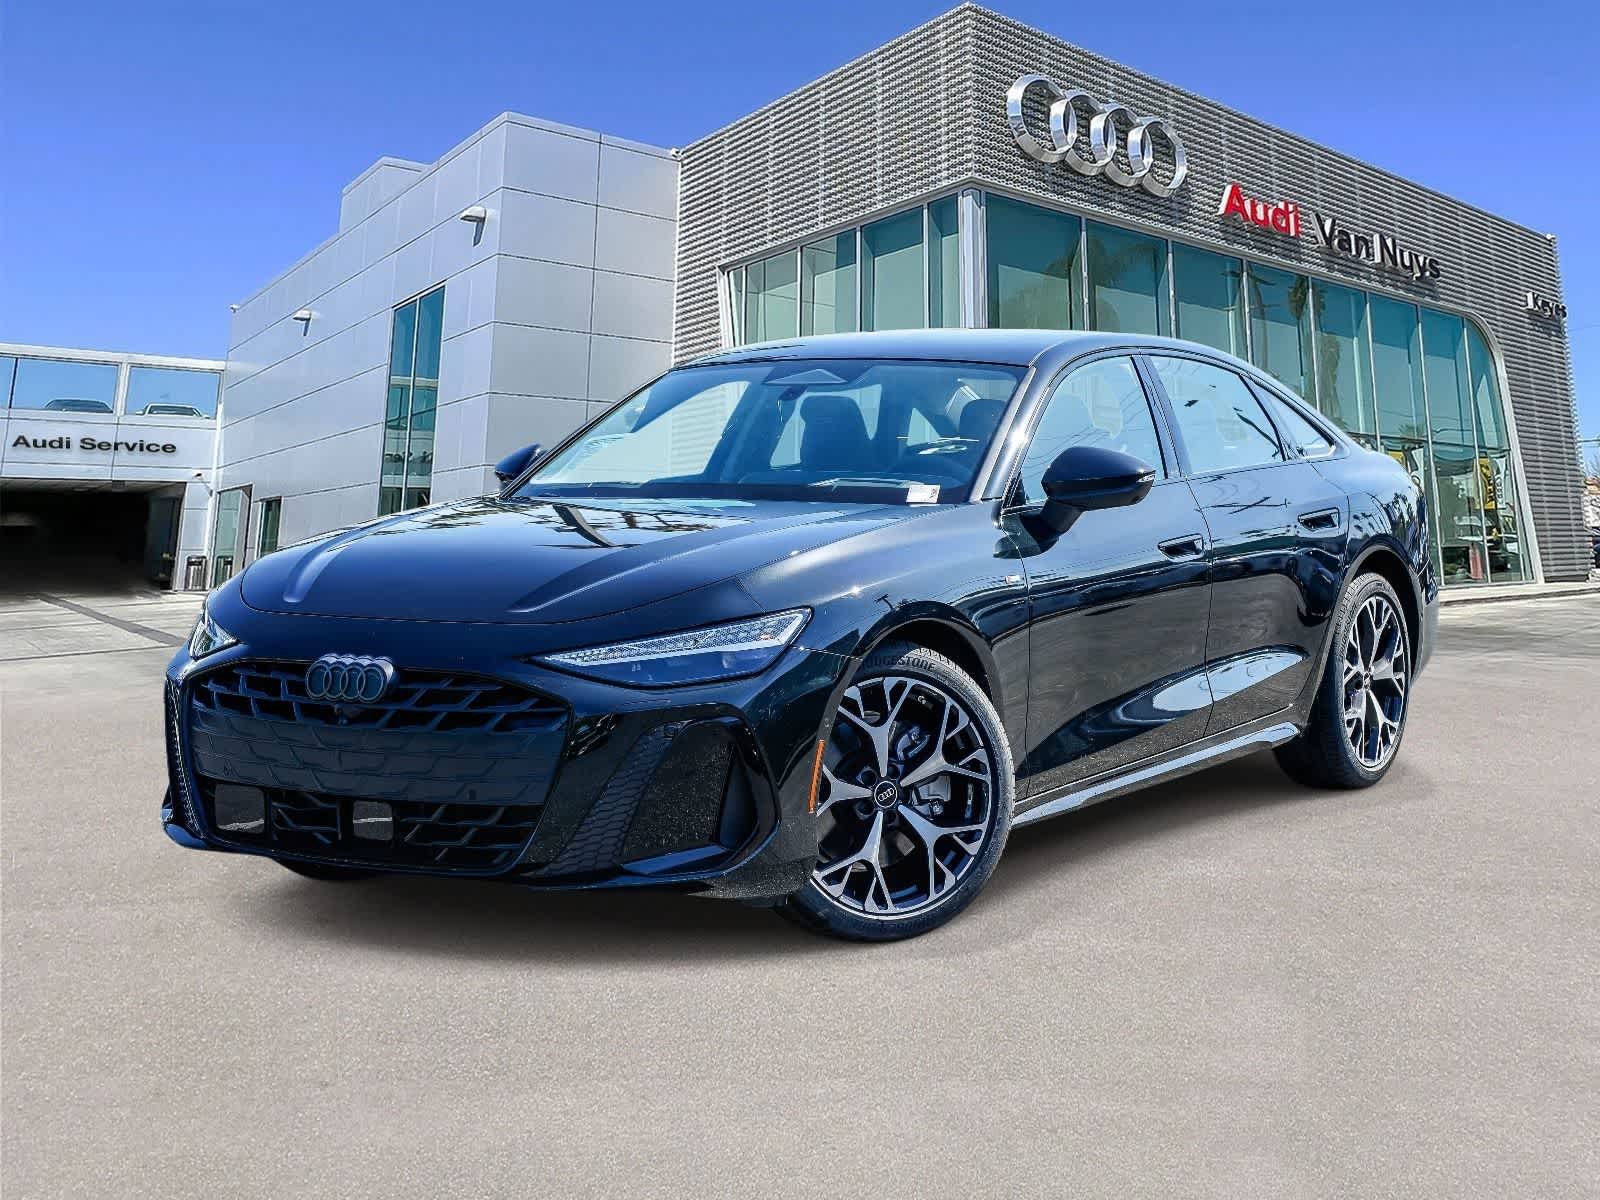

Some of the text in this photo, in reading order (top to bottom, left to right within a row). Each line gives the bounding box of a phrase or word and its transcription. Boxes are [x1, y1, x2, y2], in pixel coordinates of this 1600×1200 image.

[1218, 182, 1441, 281] Audi Van Nuys
[1526, 291, 1568, 318] Keyes
[12, 435, 177, 453] Audi Service
